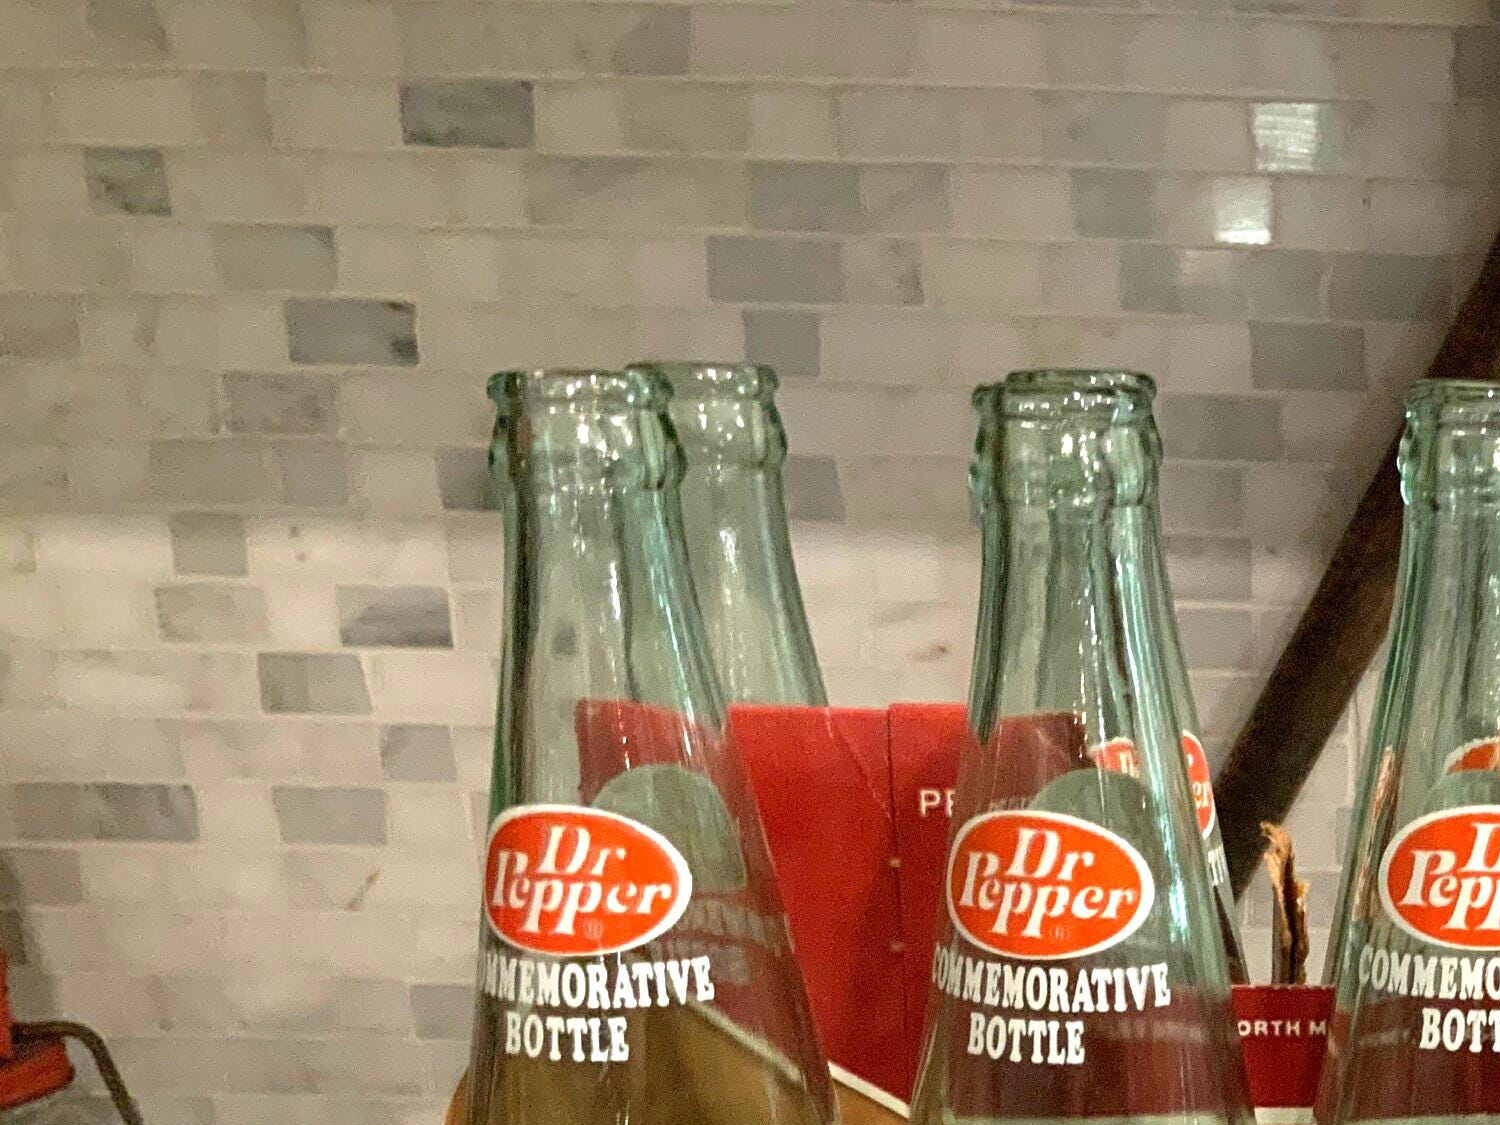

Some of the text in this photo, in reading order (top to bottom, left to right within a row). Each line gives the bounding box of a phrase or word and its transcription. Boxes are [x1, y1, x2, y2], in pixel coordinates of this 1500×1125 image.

[537, 824, 627, 876] Dr
[1005, 828, 1096, 882] Dr
[491, 849, 672, 936] Pepper
[958, 850, 1136, 940] Pepper
[484, 954, 716, 1010] MMEMORATIVE
[932, 940, 1172, 1014] COMMEMORATIVE
[505, 1011, 630, 1063] BOTTLE
[967, 1011, 1087, 1066] BOTTLE
[1237, 1020, 1301, 1037] ORTH
